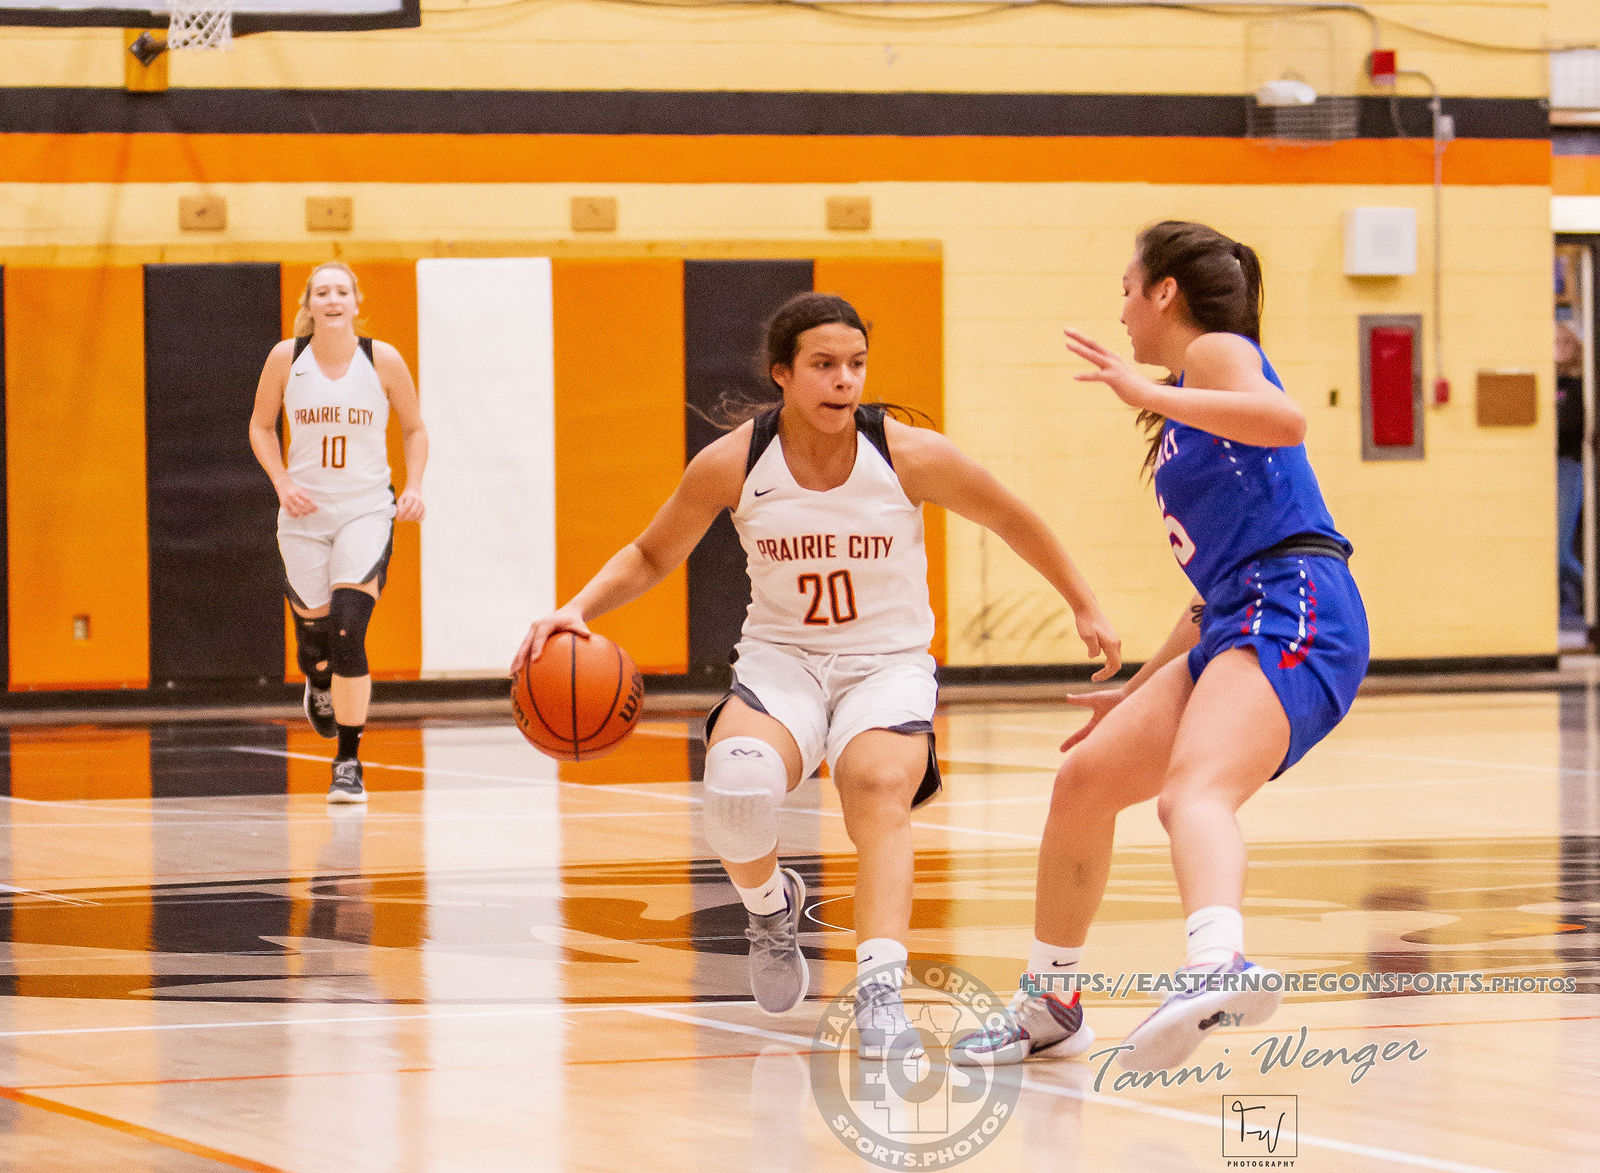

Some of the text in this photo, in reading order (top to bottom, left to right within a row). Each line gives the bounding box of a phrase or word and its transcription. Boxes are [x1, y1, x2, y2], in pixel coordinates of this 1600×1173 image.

[295, 406, 374, 426] PRAIRIE CITY
[322, 435, 347, 469] 10
[756, 534, 894, 562] PRAIRIE CITY
[797, 569, 859, 625] 20
